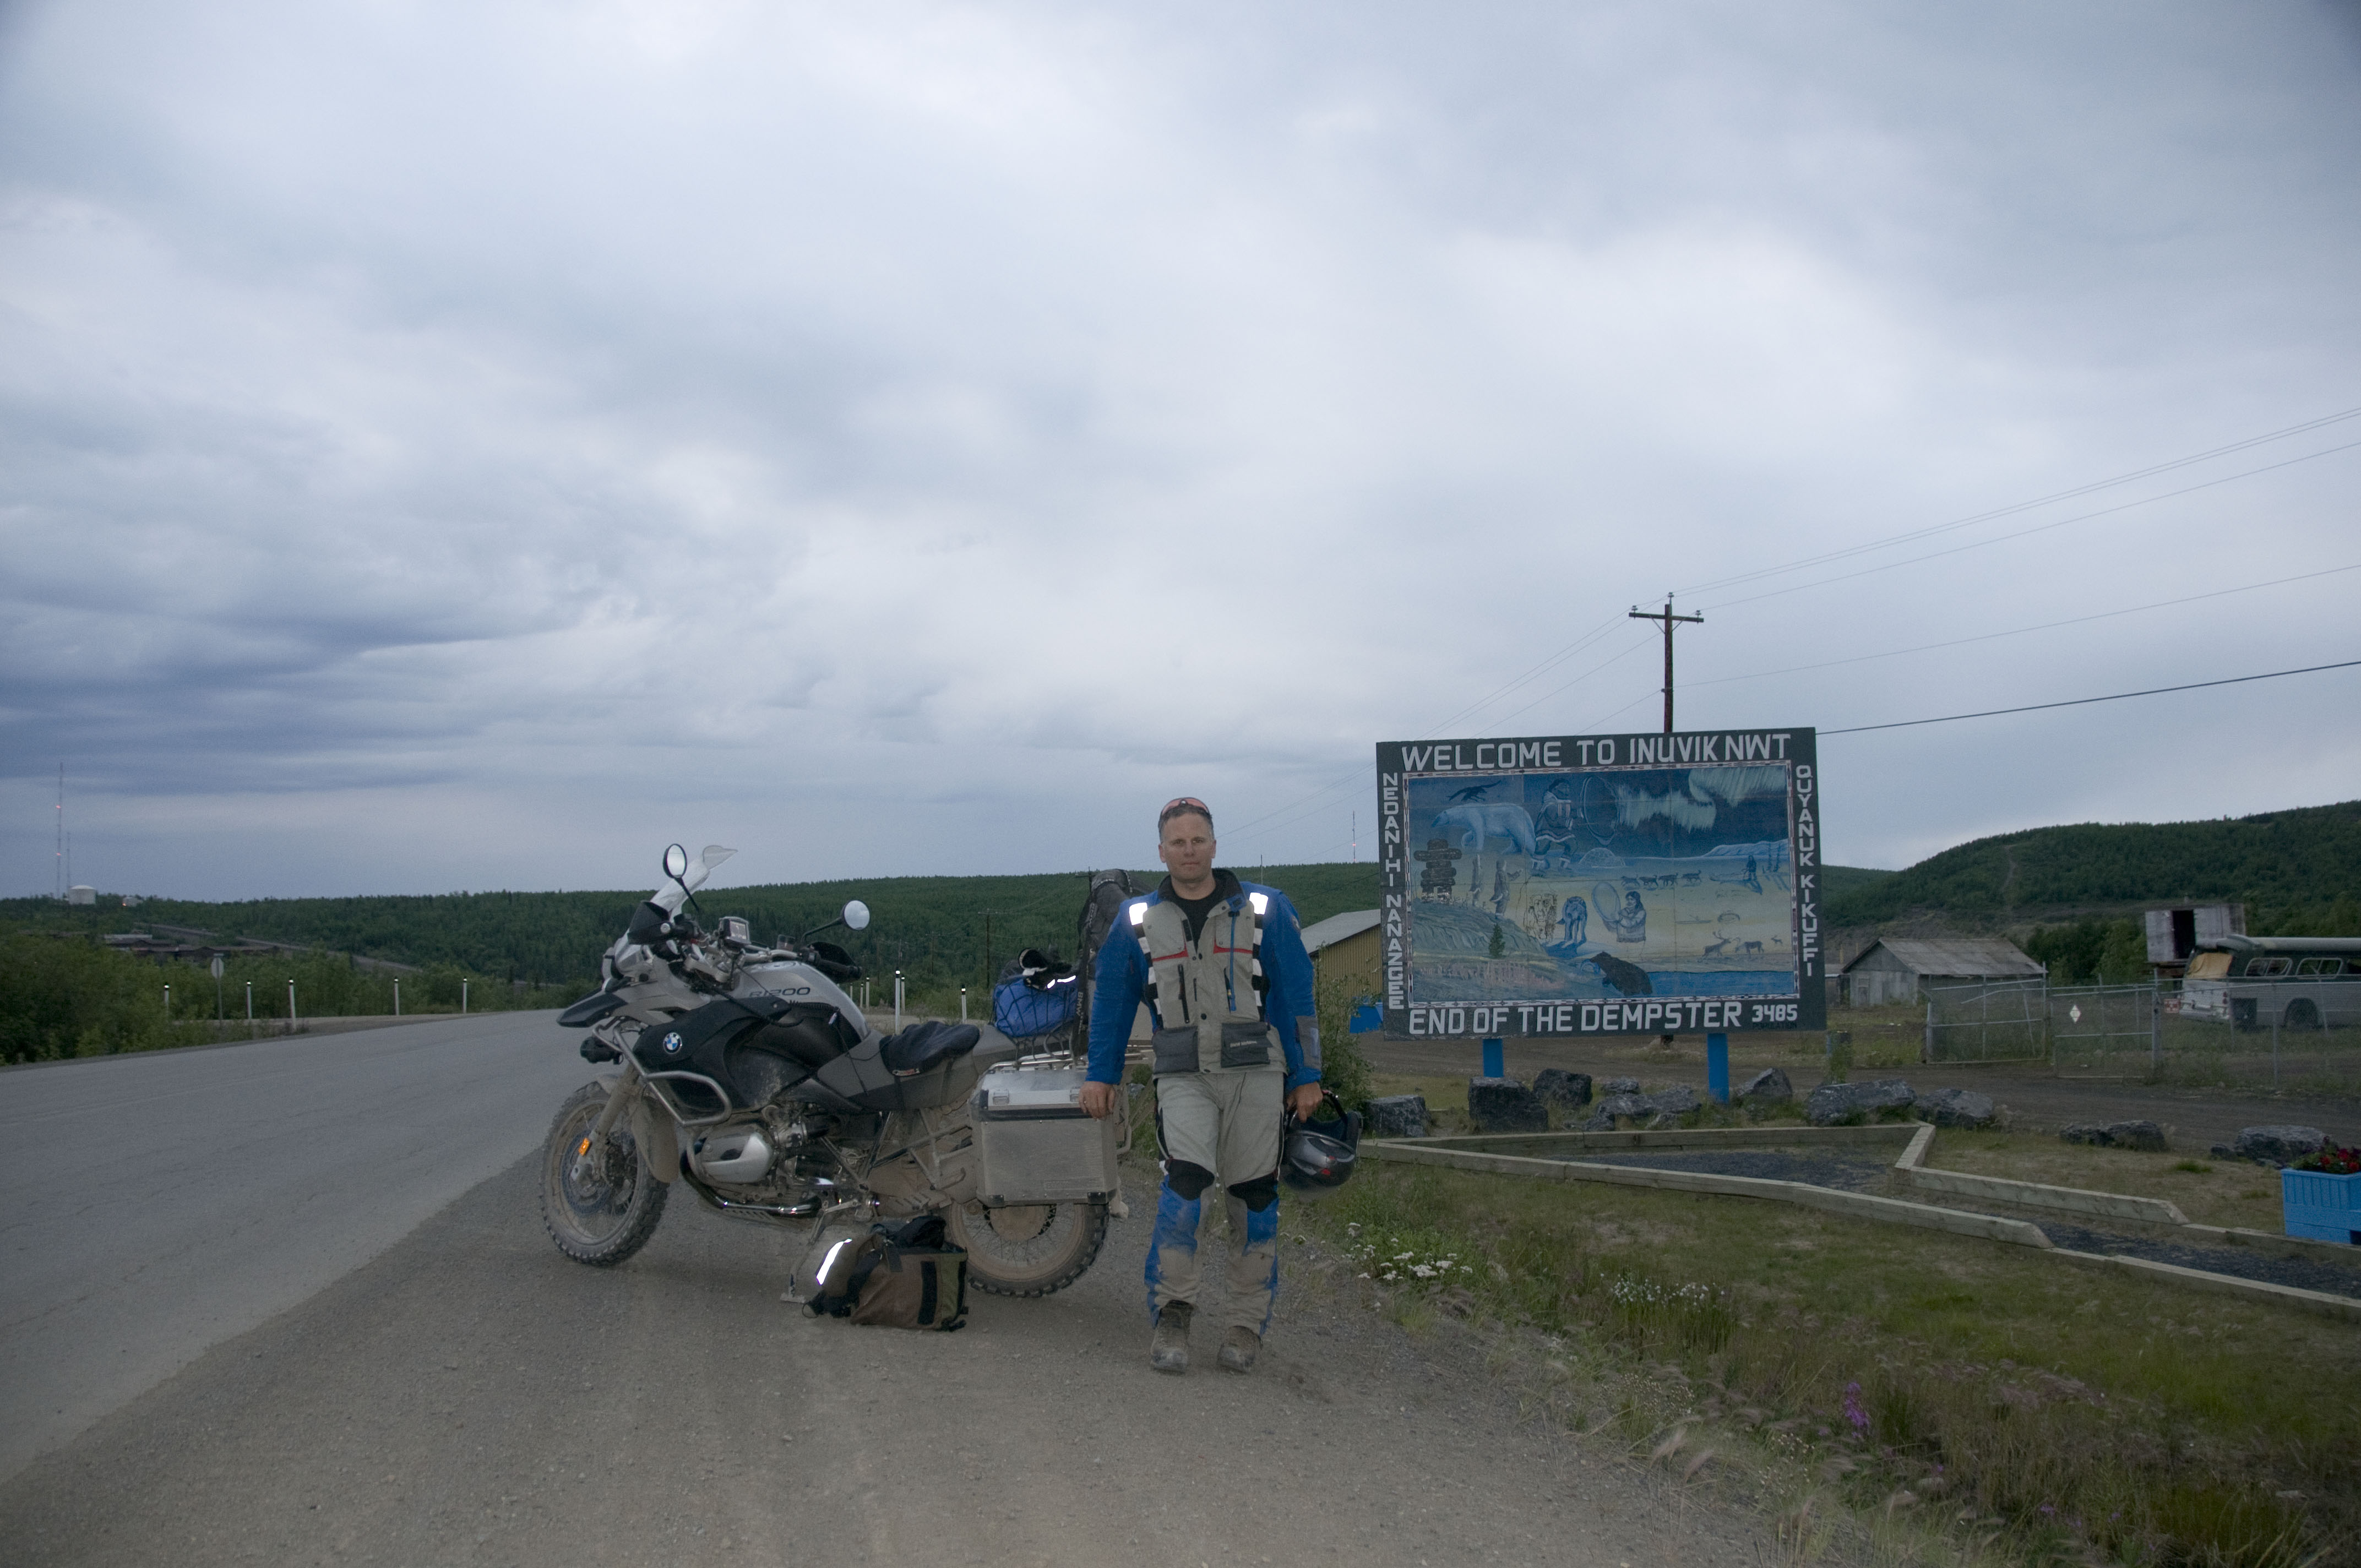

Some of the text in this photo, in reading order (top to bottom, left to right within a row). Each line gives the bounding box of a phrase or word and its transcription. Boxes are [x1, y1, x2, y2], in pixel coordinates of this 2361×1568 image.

[1401, 733, 1791, 771] WELCOME TO INUVIK NWT
[1383, 772, 1405, 1010] NEDANIHI NANAZGEE
[1796, 765, 1818, 977] QUYANUK KIKUFFI
[1409, 1001, 1798, 1035] END OF THE DEMPSTER 3485
